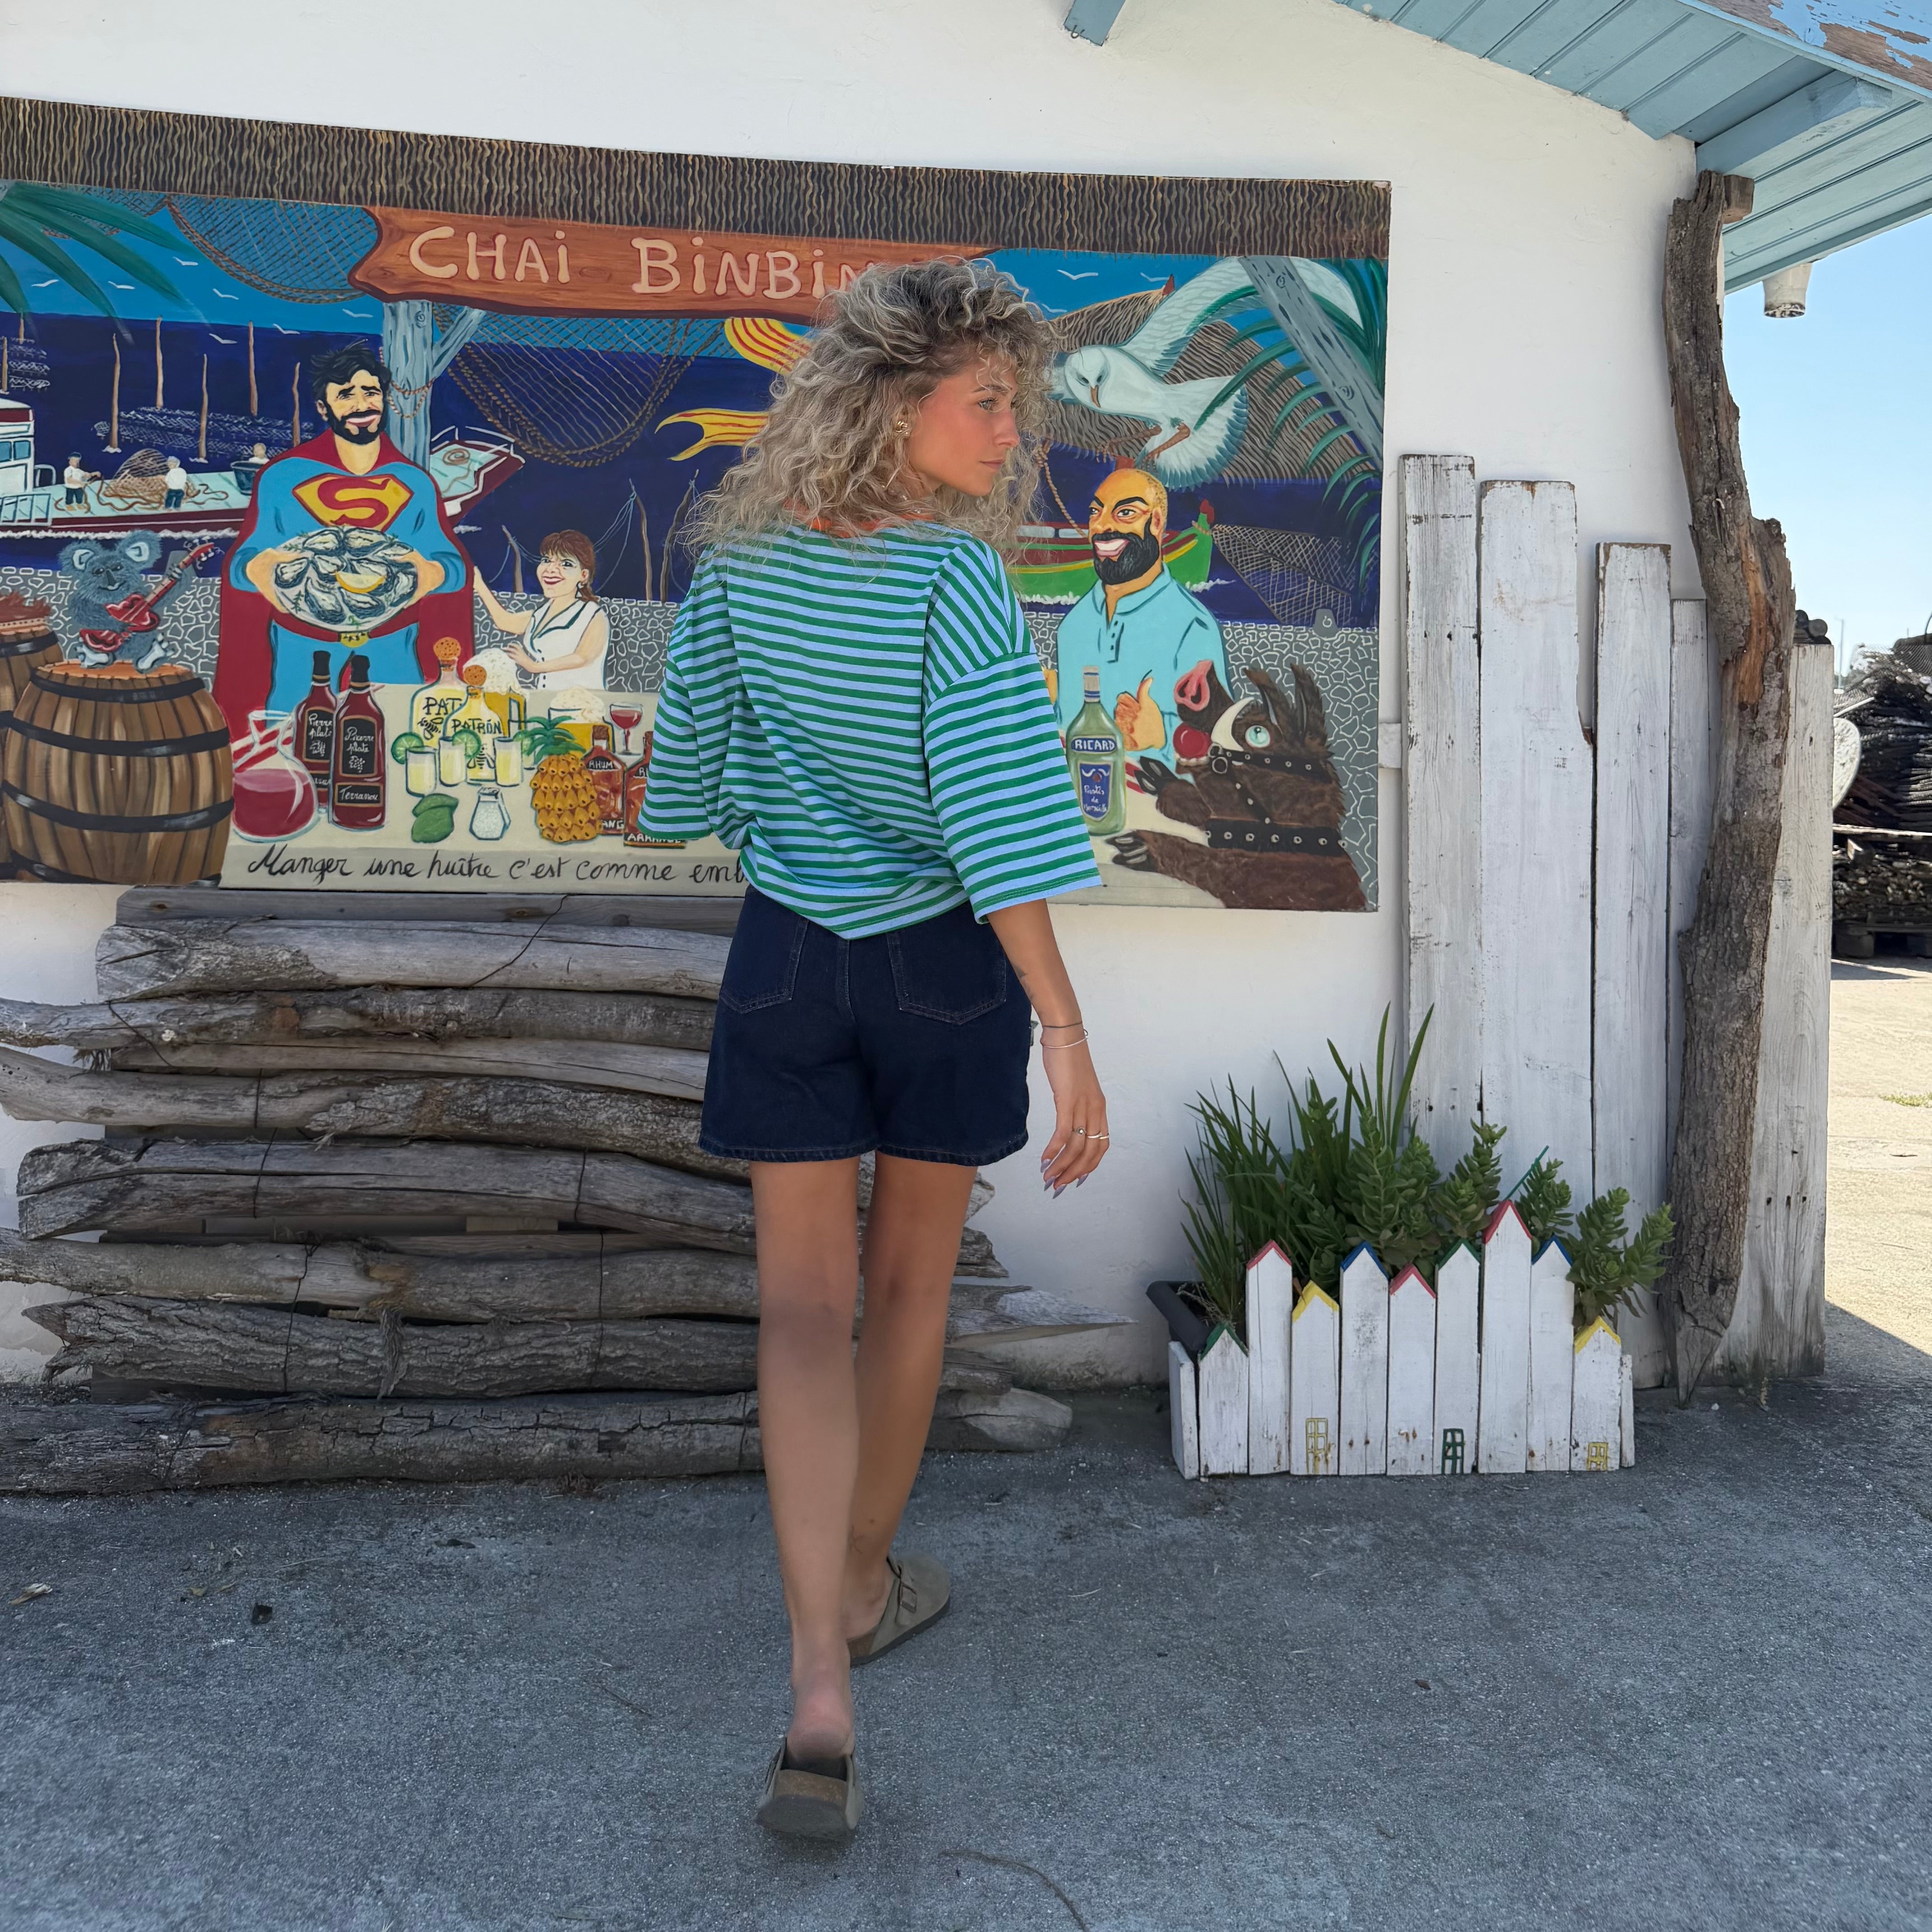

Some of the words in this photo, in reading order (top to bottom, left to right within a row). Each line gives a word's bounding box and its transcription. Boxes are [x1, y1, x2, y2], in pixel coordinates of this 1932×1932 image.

[1075, 739, 1115, 751] RICARD
[589, 760, 613, 769] RHUM
[247, 844, 355, 885] Manger
[363, 857, 426, 877] une
[509, 856, 571, 880] c'est
[576, 859, 680, 881] comme
